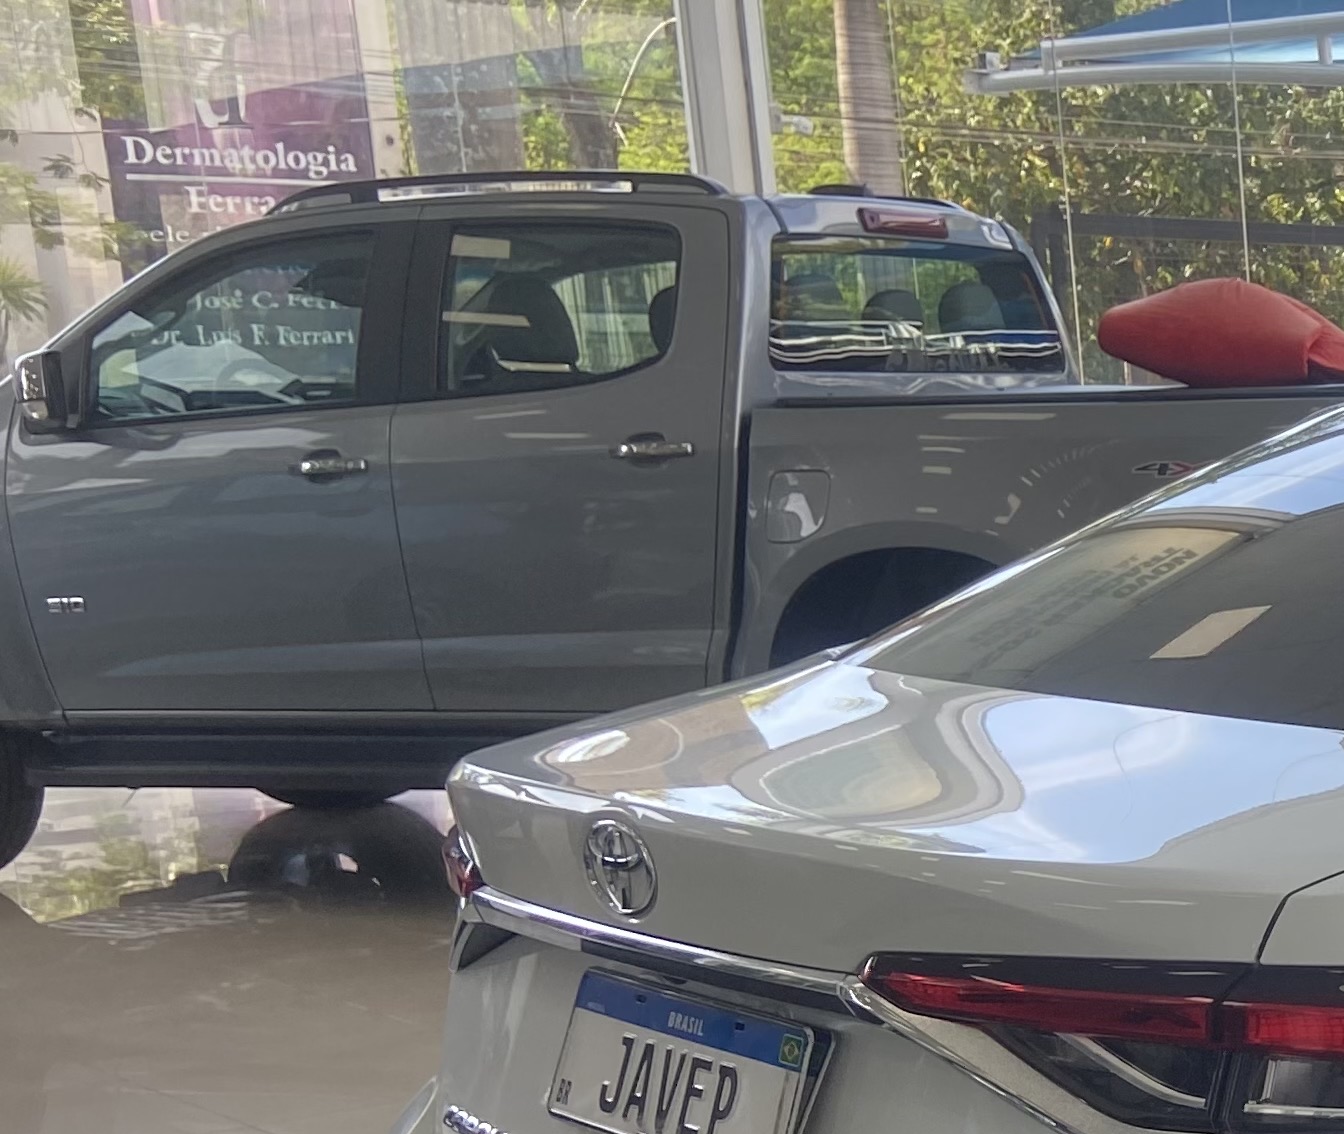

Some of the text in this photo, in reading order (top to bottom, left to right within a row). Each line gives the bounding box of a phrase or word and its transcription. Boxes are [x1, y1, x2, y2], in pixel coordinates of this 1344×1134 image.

[120, 135, 358, 180] Dermatologia
[184, 185, 276, 214] Ferra
[276, 325, 355, 346] Ferrari
[667, 1011, 703, 1036] BRASIL
